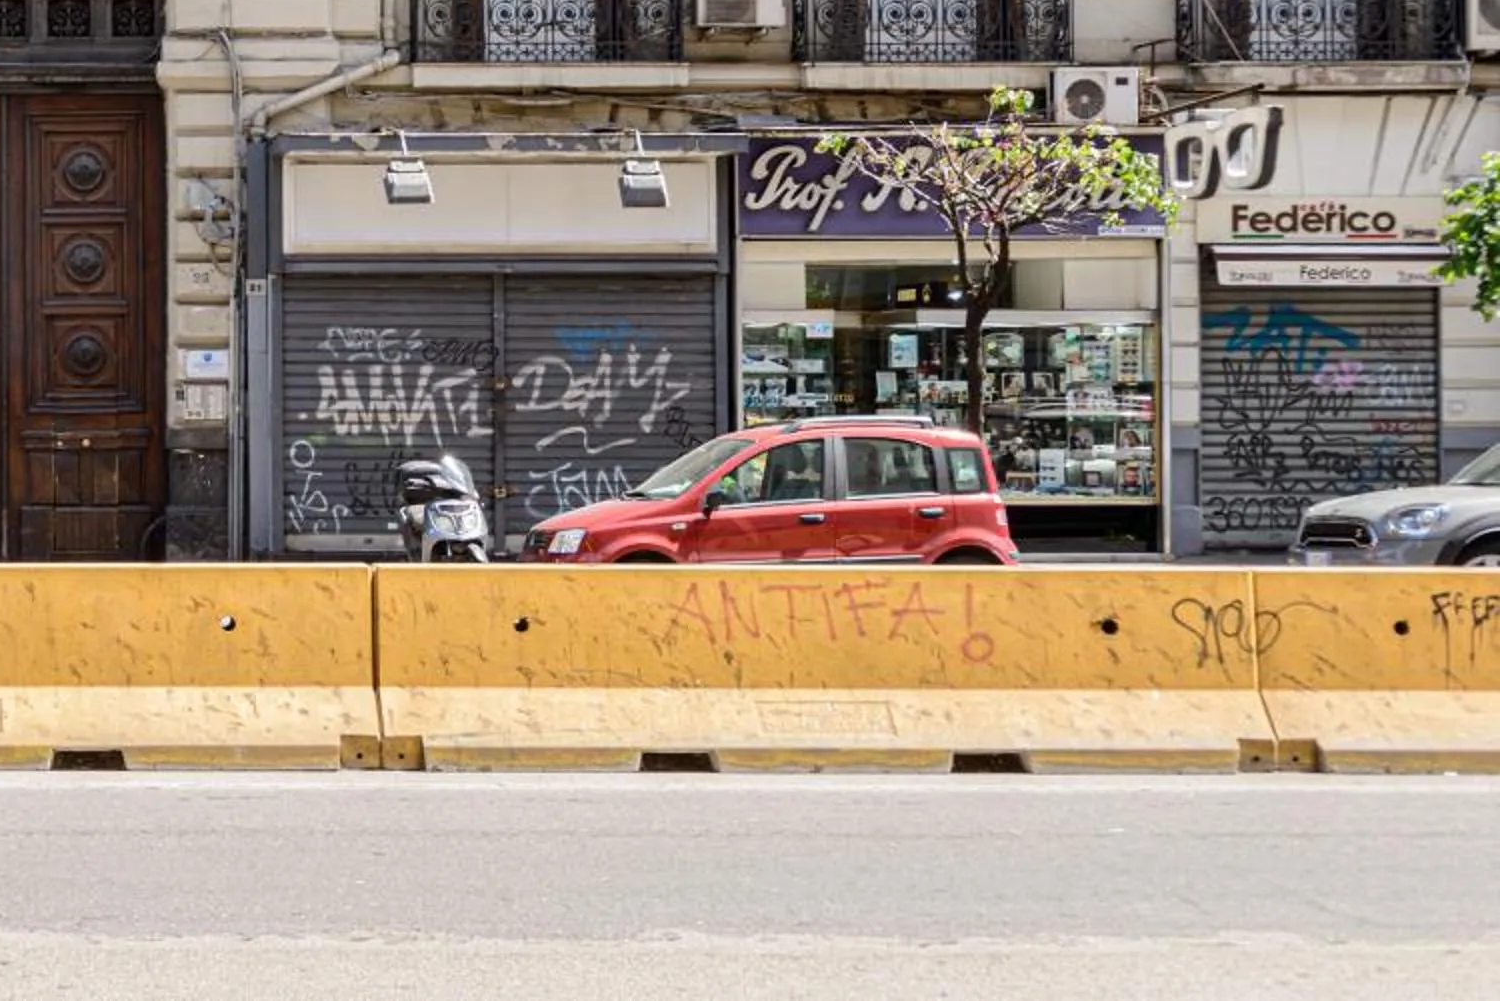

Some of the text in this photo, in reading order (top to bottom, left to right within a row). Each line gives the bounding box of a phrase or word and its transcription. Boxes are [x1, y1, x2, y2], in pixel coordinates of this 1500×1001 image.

[745, 144, 858, 232] Prof.
[1231, 204, 1397, 233] Federico
[1300, 265, 1372, 281] Federico
